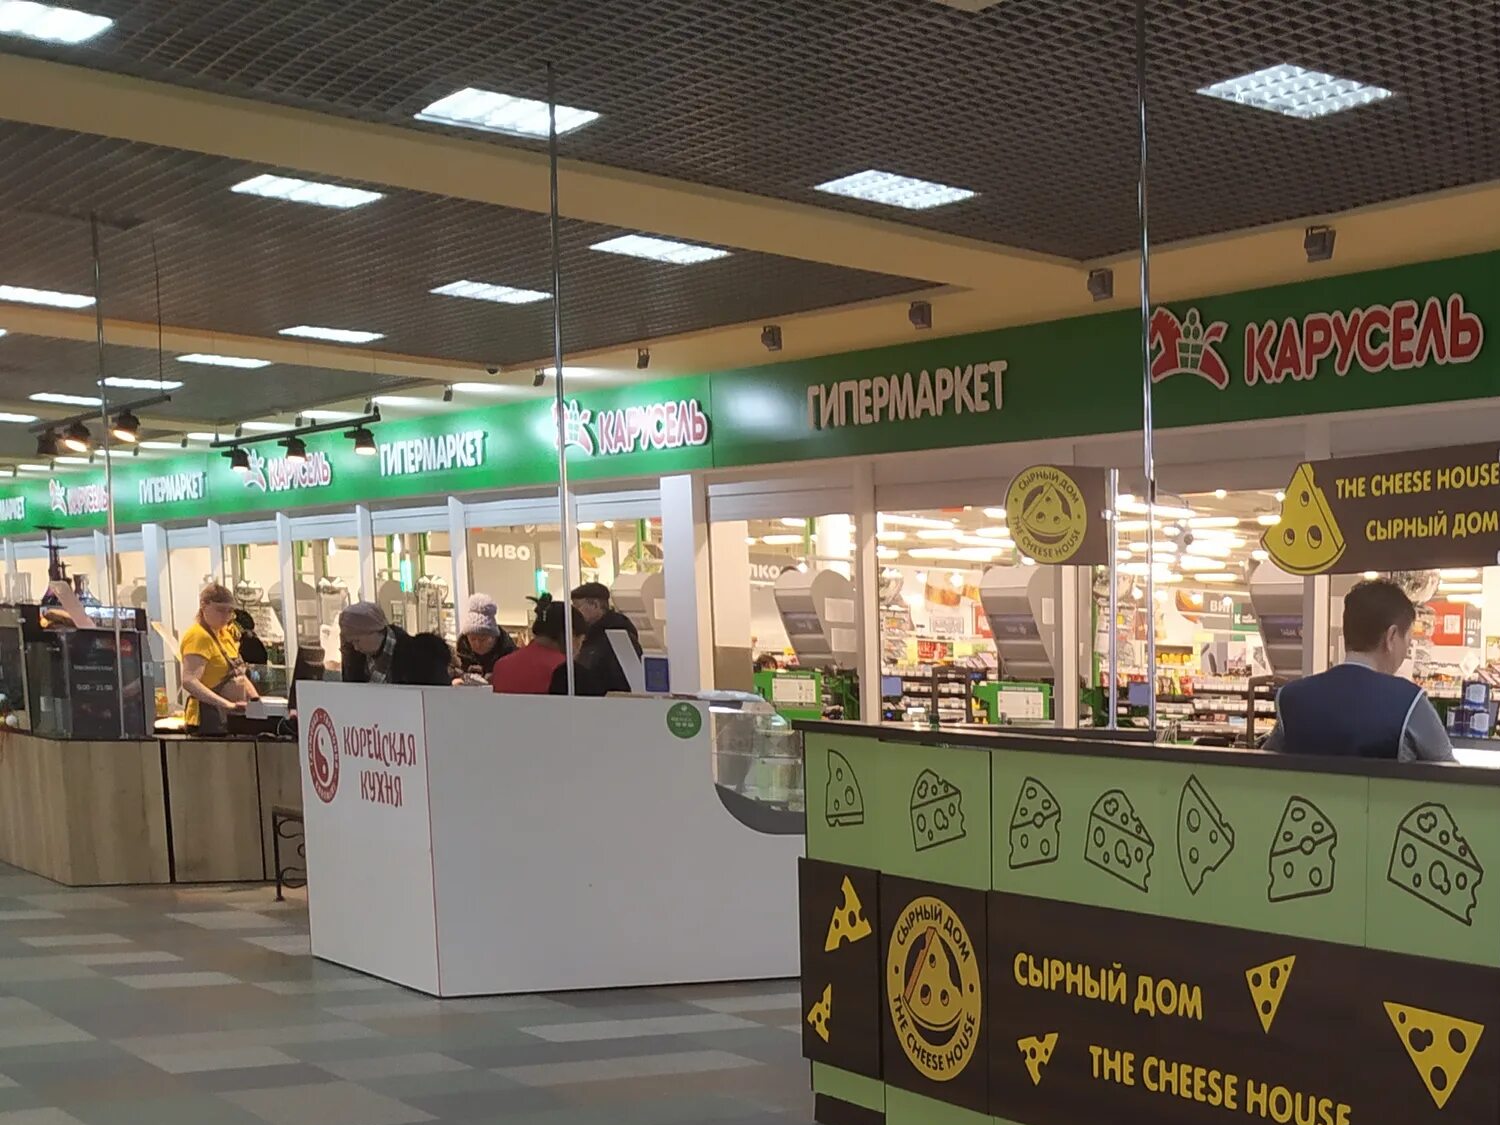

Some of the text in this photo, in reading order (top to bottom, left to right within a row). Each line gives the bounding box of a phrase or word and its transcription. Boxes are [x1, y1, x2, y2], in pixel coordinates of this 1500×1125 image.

[1244, 293, 1484, 387] КАРУСЕЛЬ
[807, 359, 1008, 431] ГИПЕРМАРКЕТ
[598, 398, 709, 456] КАРУСЕЛЬ
[267, 451, 331, 492] КАРУСЕЛЬ
[380, 430, 486, 477] ГИПЕРМАРКЕТ
[139, 472, 206, 505] ГИПЕРМАРКЕТ
[1018, 470, 1080, 504] СЫРНЫЙ ДОМ
[1335, 463, 1500, 499] THE CHEESE HOUSE
[1012, 514, 1081, 558] THE CHEESE HOUSE
[1366, 510, 1499, 542] СЫРНЫЙ ДОМ
[477, 543, 530, 560] ПИВО
[343, 723, 417, 767] КОРЕЙСКАЯ
[360, 770, 403, 808] КУХНЯ
[897, 903, 970, 963] СЫРНЫЙ ДОМ
[1014, 952, 1203, 1021] СЫРНЫЙ ДОМ
[893, 993, 976, 1072] THE CHEESE HOUSE
[1089, 1045, 1135, 1086] THE
[1142, 1056, 1239, 1110] CHEESE
